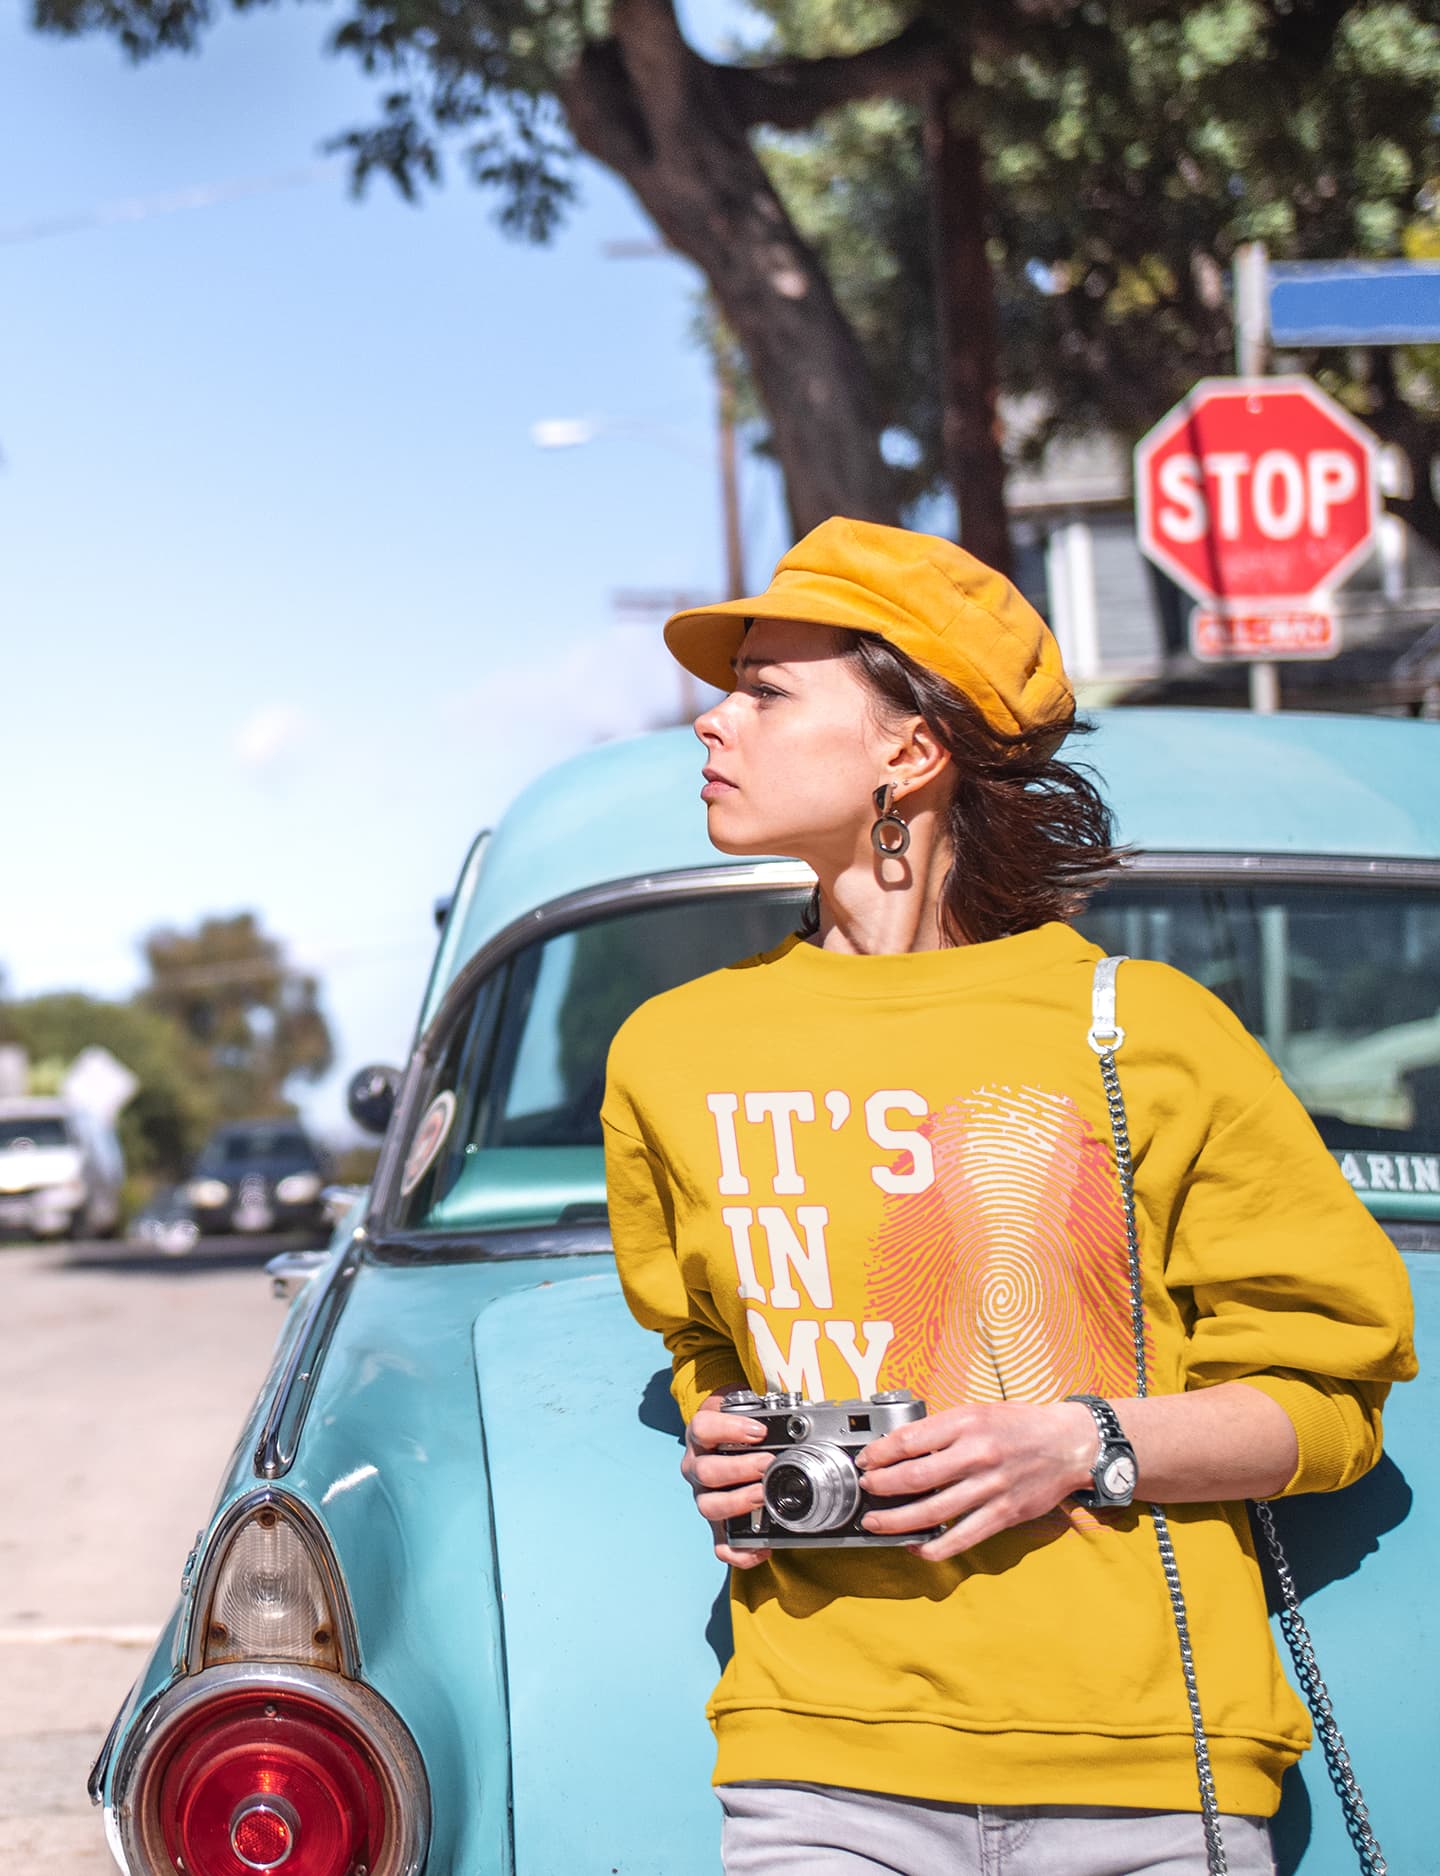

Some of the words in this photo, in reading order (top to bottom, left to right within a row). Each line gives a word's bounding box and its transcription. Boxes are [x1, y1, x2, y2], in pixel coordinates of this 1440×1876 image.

[1159, 449, 1358, 543] STOP
[706, 1089, 936, 1196] IT’S
[721, 1205, 834, 1310] IN
[745, 1308, 896, 1403] MY
